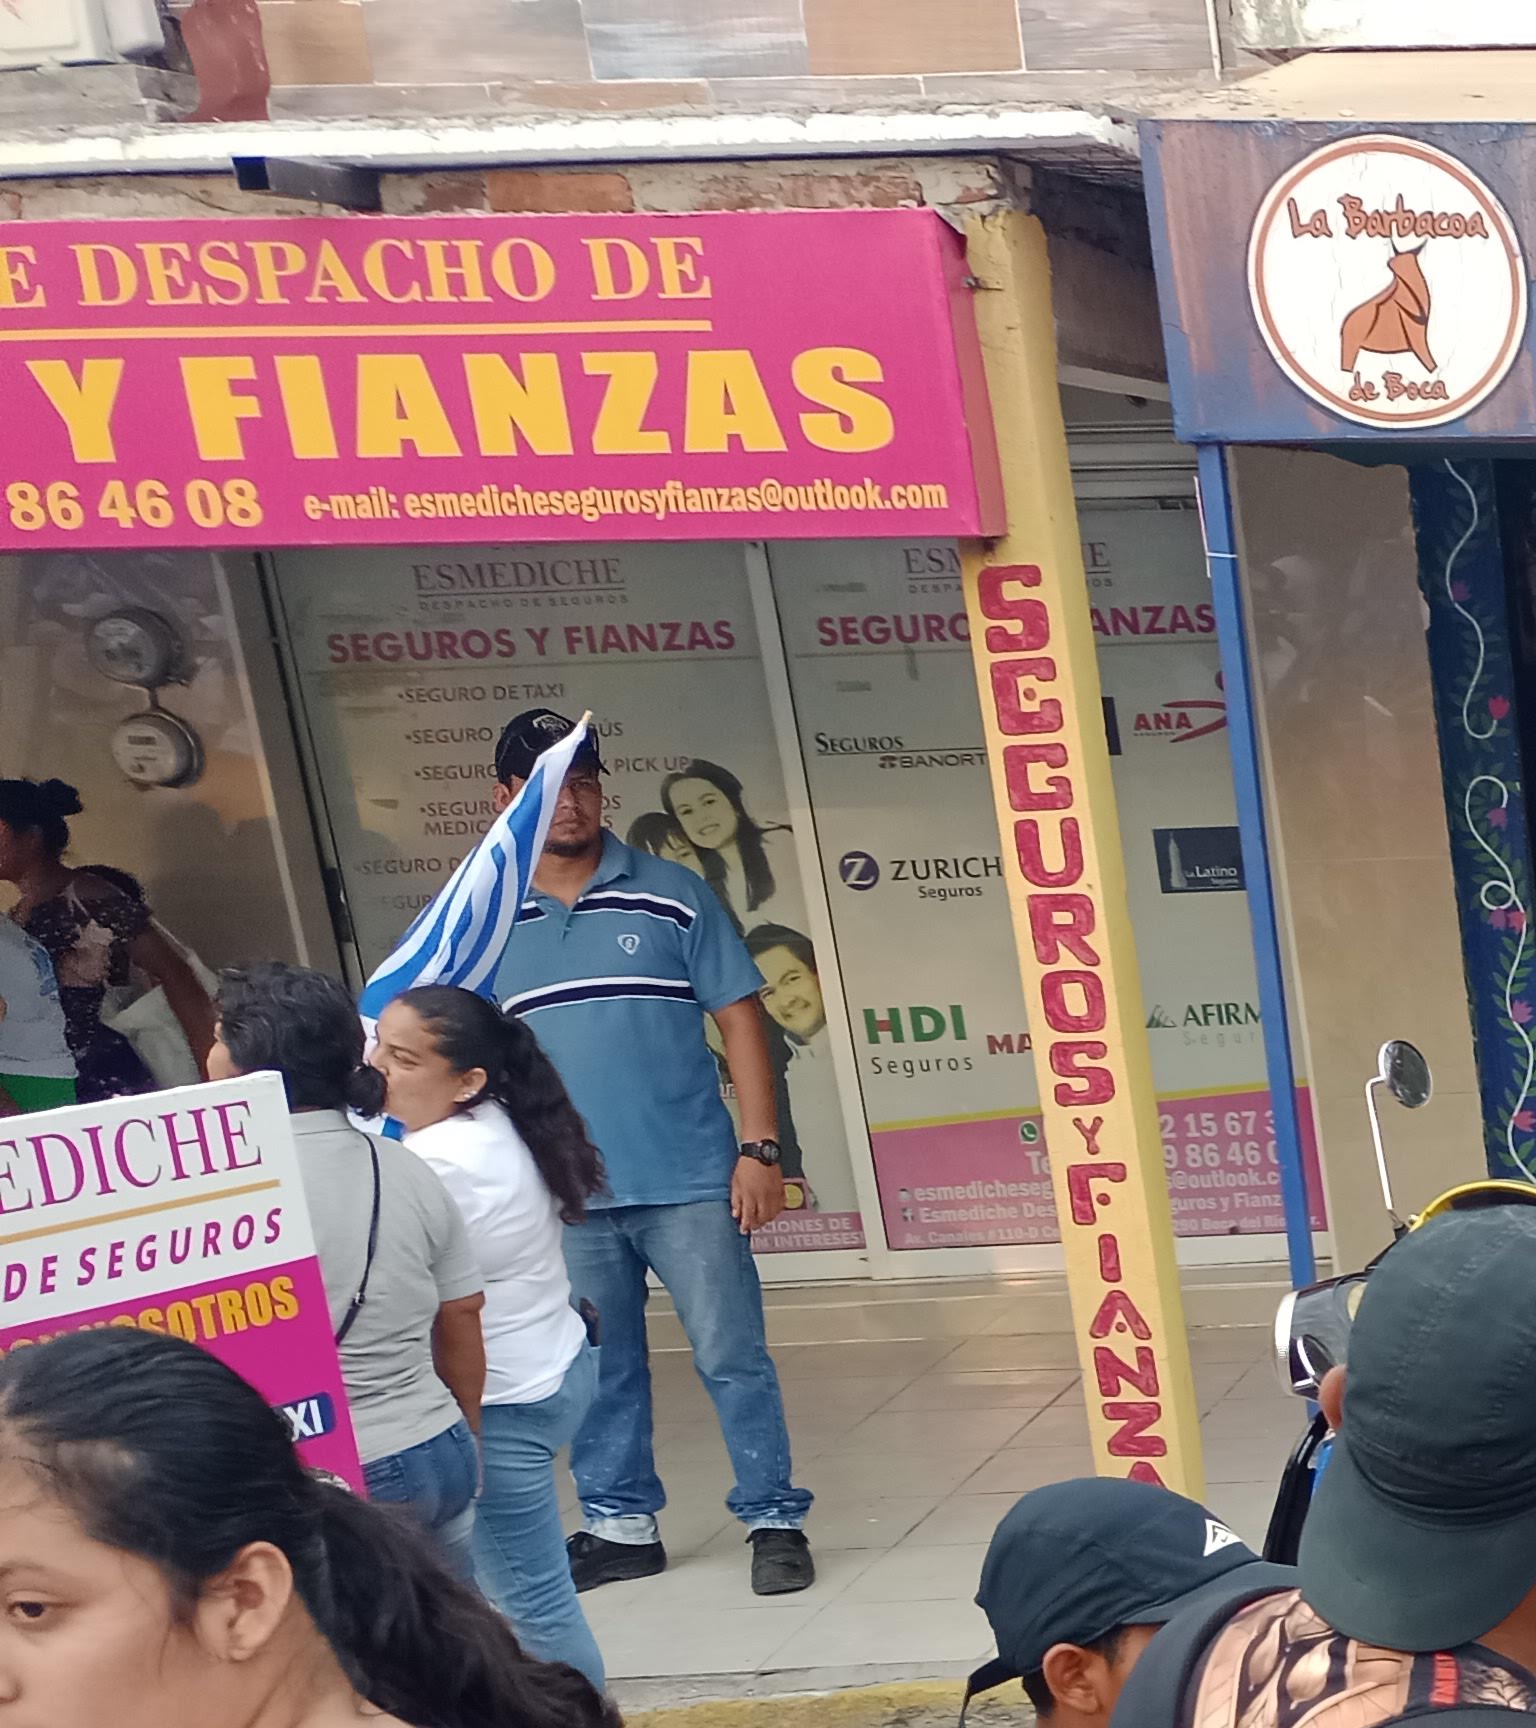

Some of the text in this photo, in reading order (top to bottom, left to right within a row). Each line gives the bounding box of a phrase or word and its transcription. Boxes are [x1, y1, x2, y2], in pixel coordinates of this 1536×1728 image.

[1287, 192, 1489, 239] La Barbacoa
[77, 238, 557, 308] DESPACHO
[581, 236, 713, 303] DE
[1349, 371, 1450, 402] de Boca
[25, 345, 895, 463] Y FIANZAS
[6, 476, 949, 531] 86 46 08 e-mail: esmedichesegurosyfianzas@outlook.com
[411, 558, 625, 591] ESMEDICHE
[327, 620, 736, 664] SEGUROS Y FIANZAS
[493, 685, 519, 701] DE
[522, 683, 565, 700] TAXI
[1133, 711, 1194, 731] ANA
[900, 752, 986, 768] BANORT
[977, 564, 1115, 1106] SEGUROS
[890, 857, 1002, 882] ZURICH
[1195, 865, 1237, 878] Latino
[917, 883, 983, 900] Seguros
[862, 1004, 968, 1044] HDI
[871, 1056, 973, 1077] Seguros
[1183, 1112, 1218, 1138] 15
[1224, 1111, 1257, 1136] 67
[1185, 1143, 1221, 1168] 86
[1226, 1141, 1261, 1166] 46
[919, 1206, 1018, 1222] Esmediche
[4, 1207, 282, 1300] DE SEGUROS
